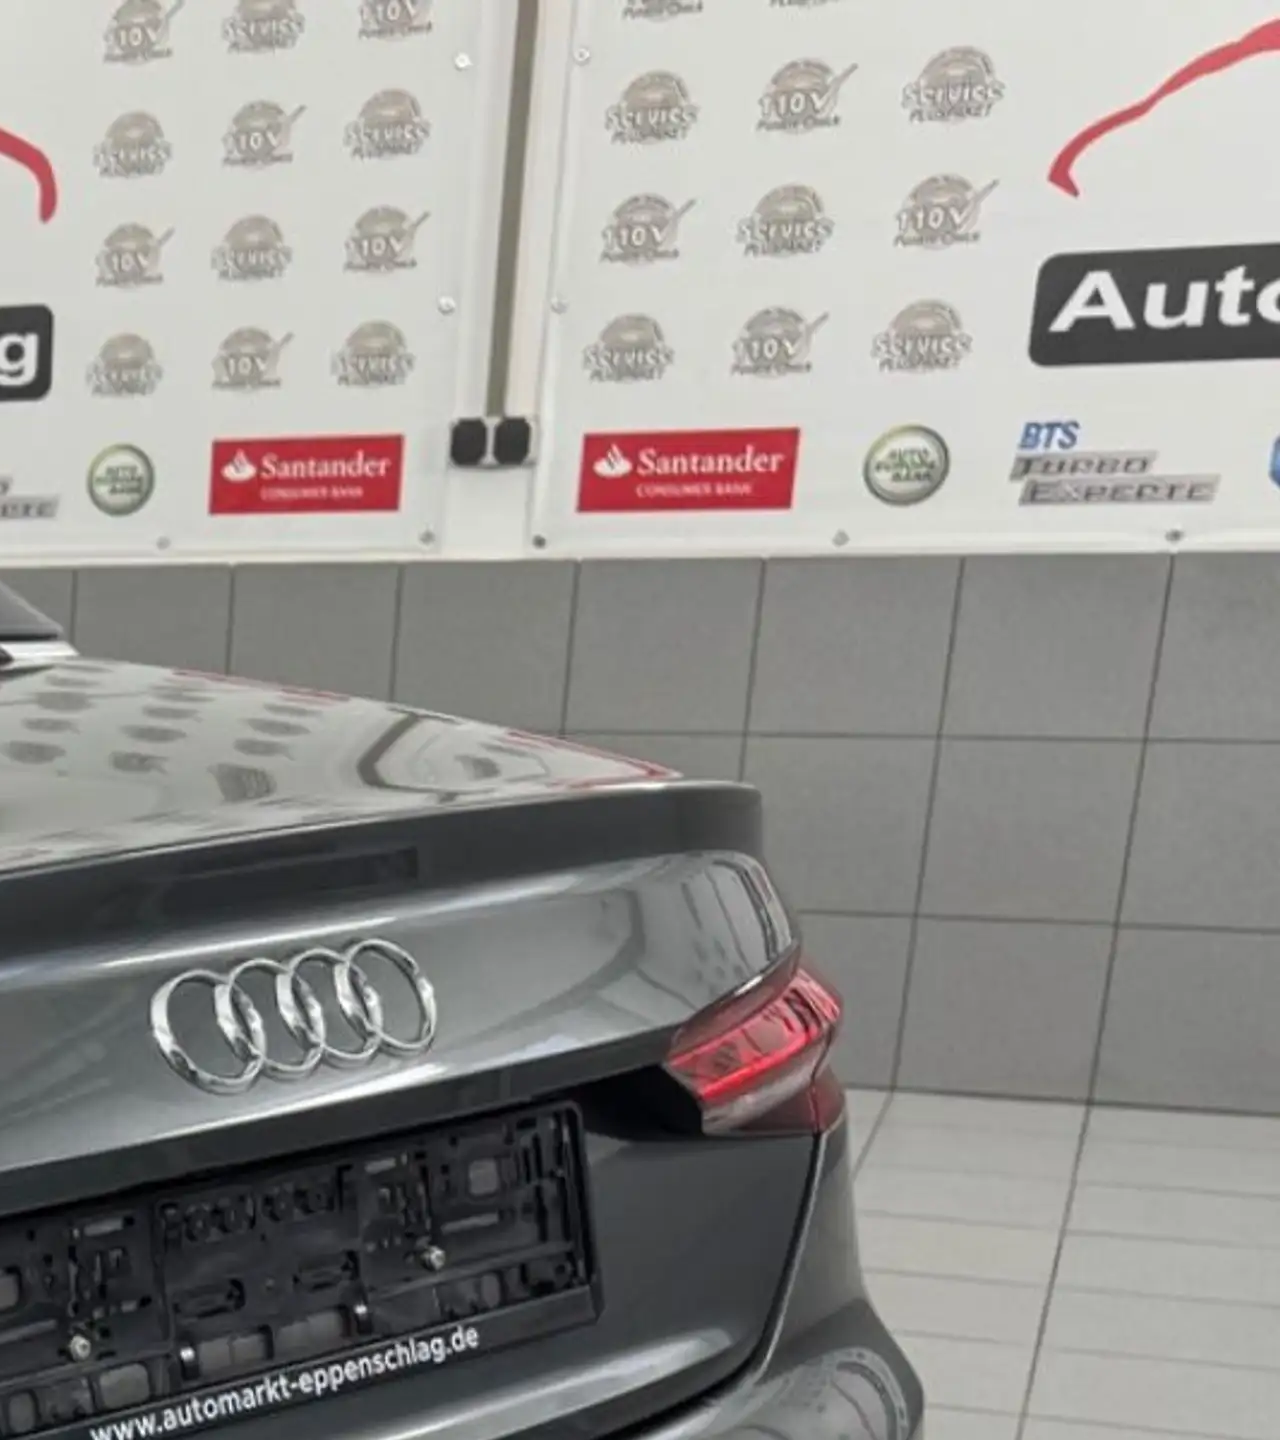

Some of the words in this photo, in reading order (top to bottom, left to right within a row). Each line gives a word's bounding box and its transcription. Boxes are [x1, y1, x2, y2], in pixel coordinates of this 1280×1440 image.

[1018, 420, 1080, 450] BTS
[261, 449, 392, 480] Santander
[637, 443, 784, 477] Santander
